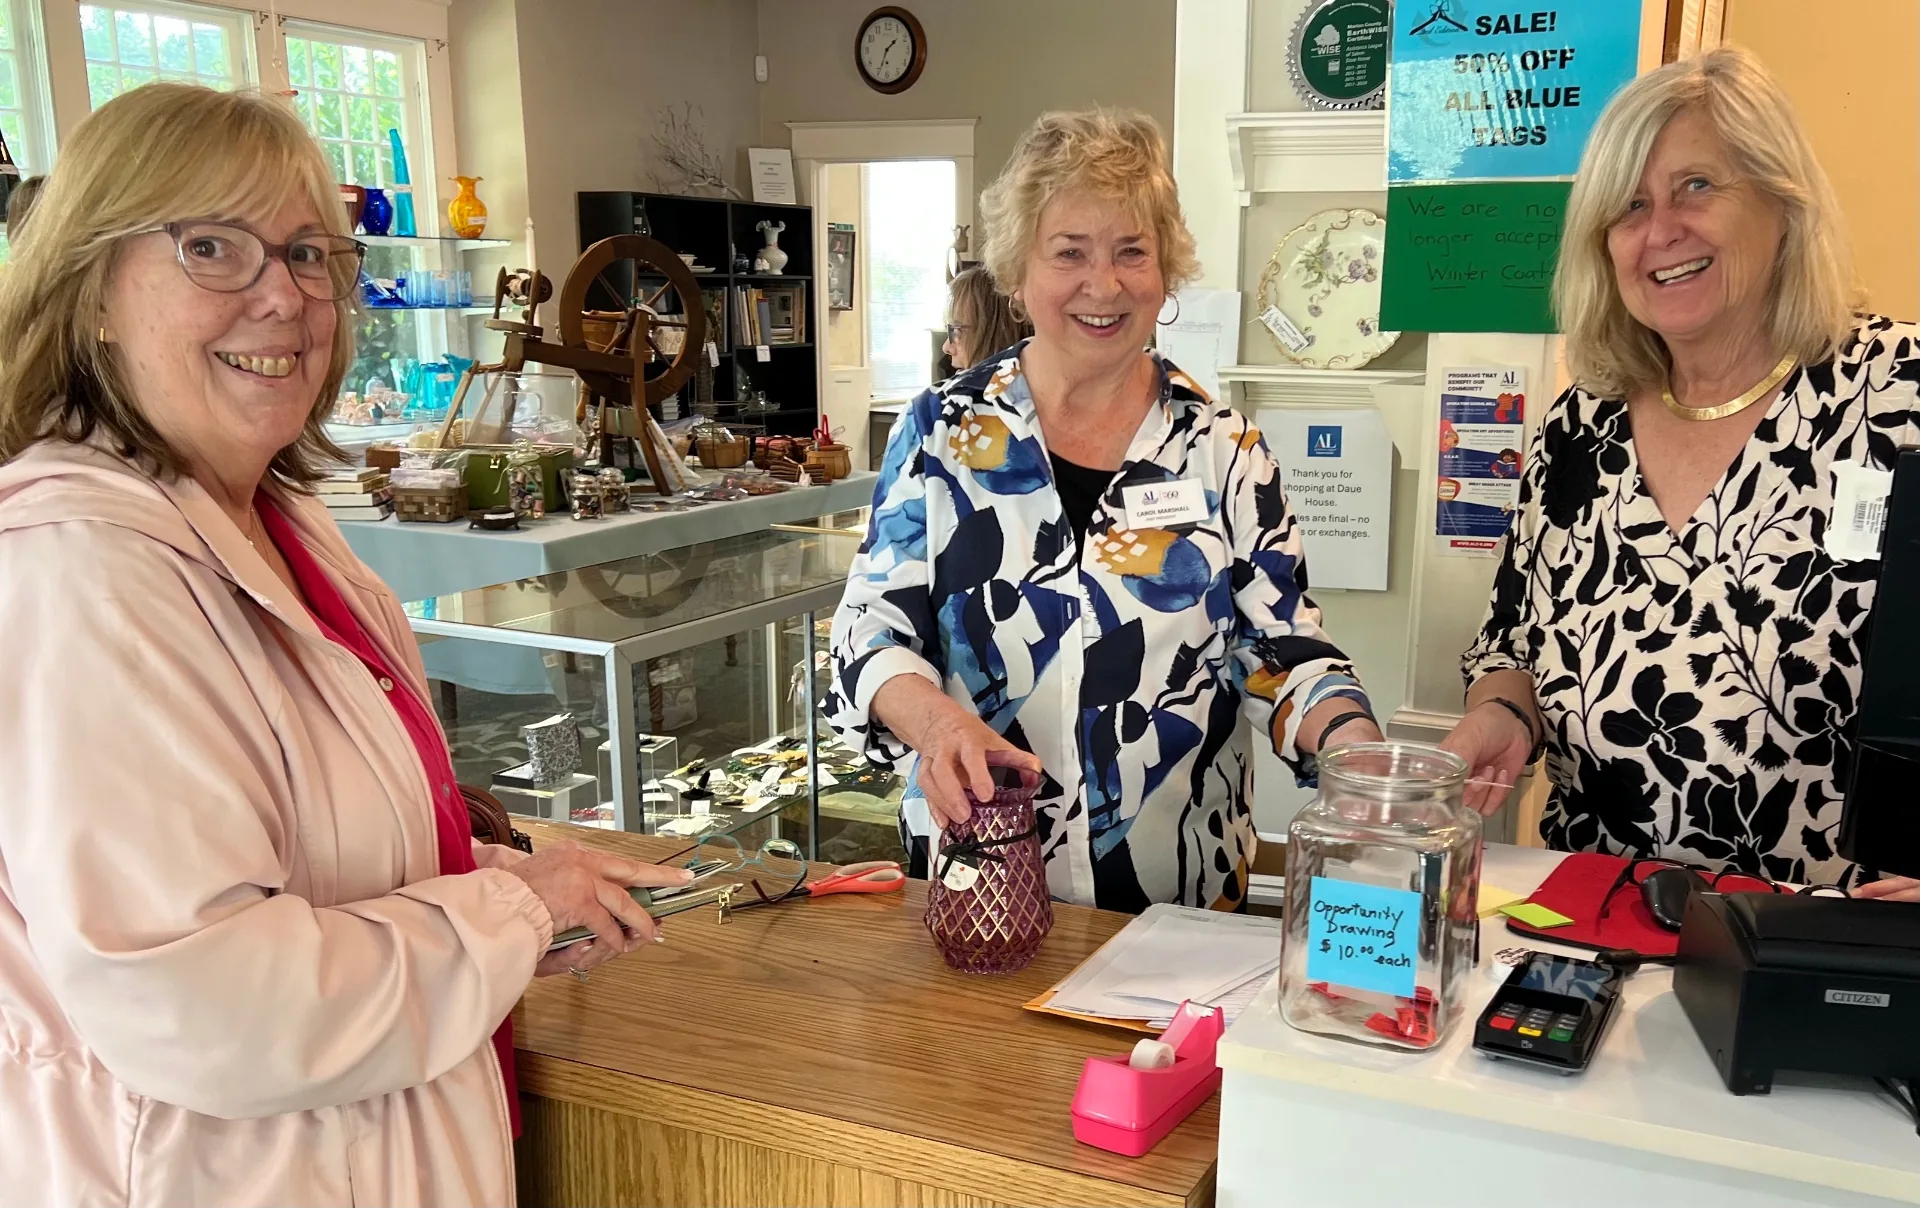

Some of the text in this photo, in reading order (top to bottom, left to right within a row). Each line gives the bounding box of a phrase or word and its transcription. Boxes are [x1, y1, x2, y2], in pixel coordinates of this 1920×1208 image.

[884, 22, 892, 30] 12
[1475, 12, 1556, 35] SALE!
[1317, 45, 1341, 55] WISE
[1454, 48, 1575, 74] 50% OFF
[1444, 86, 1580, 112] ALL BLUE
[1472, 126, 1547, 148] TAGS
[1408, 196, 1557, 217] We are no
[1408, 230, 1475, 257] longer
[1426, 260, 1490, 281] Winter
[1501, 371, 1519, 384] AL
[1314, 433, 1337, 448] AL
[1292, 468, 1353, 479] Thank you for
[1283, 483, 1362, 494] shopping at Daue
[1305, 498, 1338, 507] House.
[1136, 505, 1190, 517] CAROL MARSHALL
[1328, 514, 1349, 523] final
[1357, 516, 1370, 524] no
[1318, 528, 1370, 539] exchanges.
[1314, 900, 1404, 930] Opportunity
[1326, 920, 1395, 948] Drawing
[1374, 953, 1411, 967] each
[1832, 992, 1883, 1004] CITIZEN
